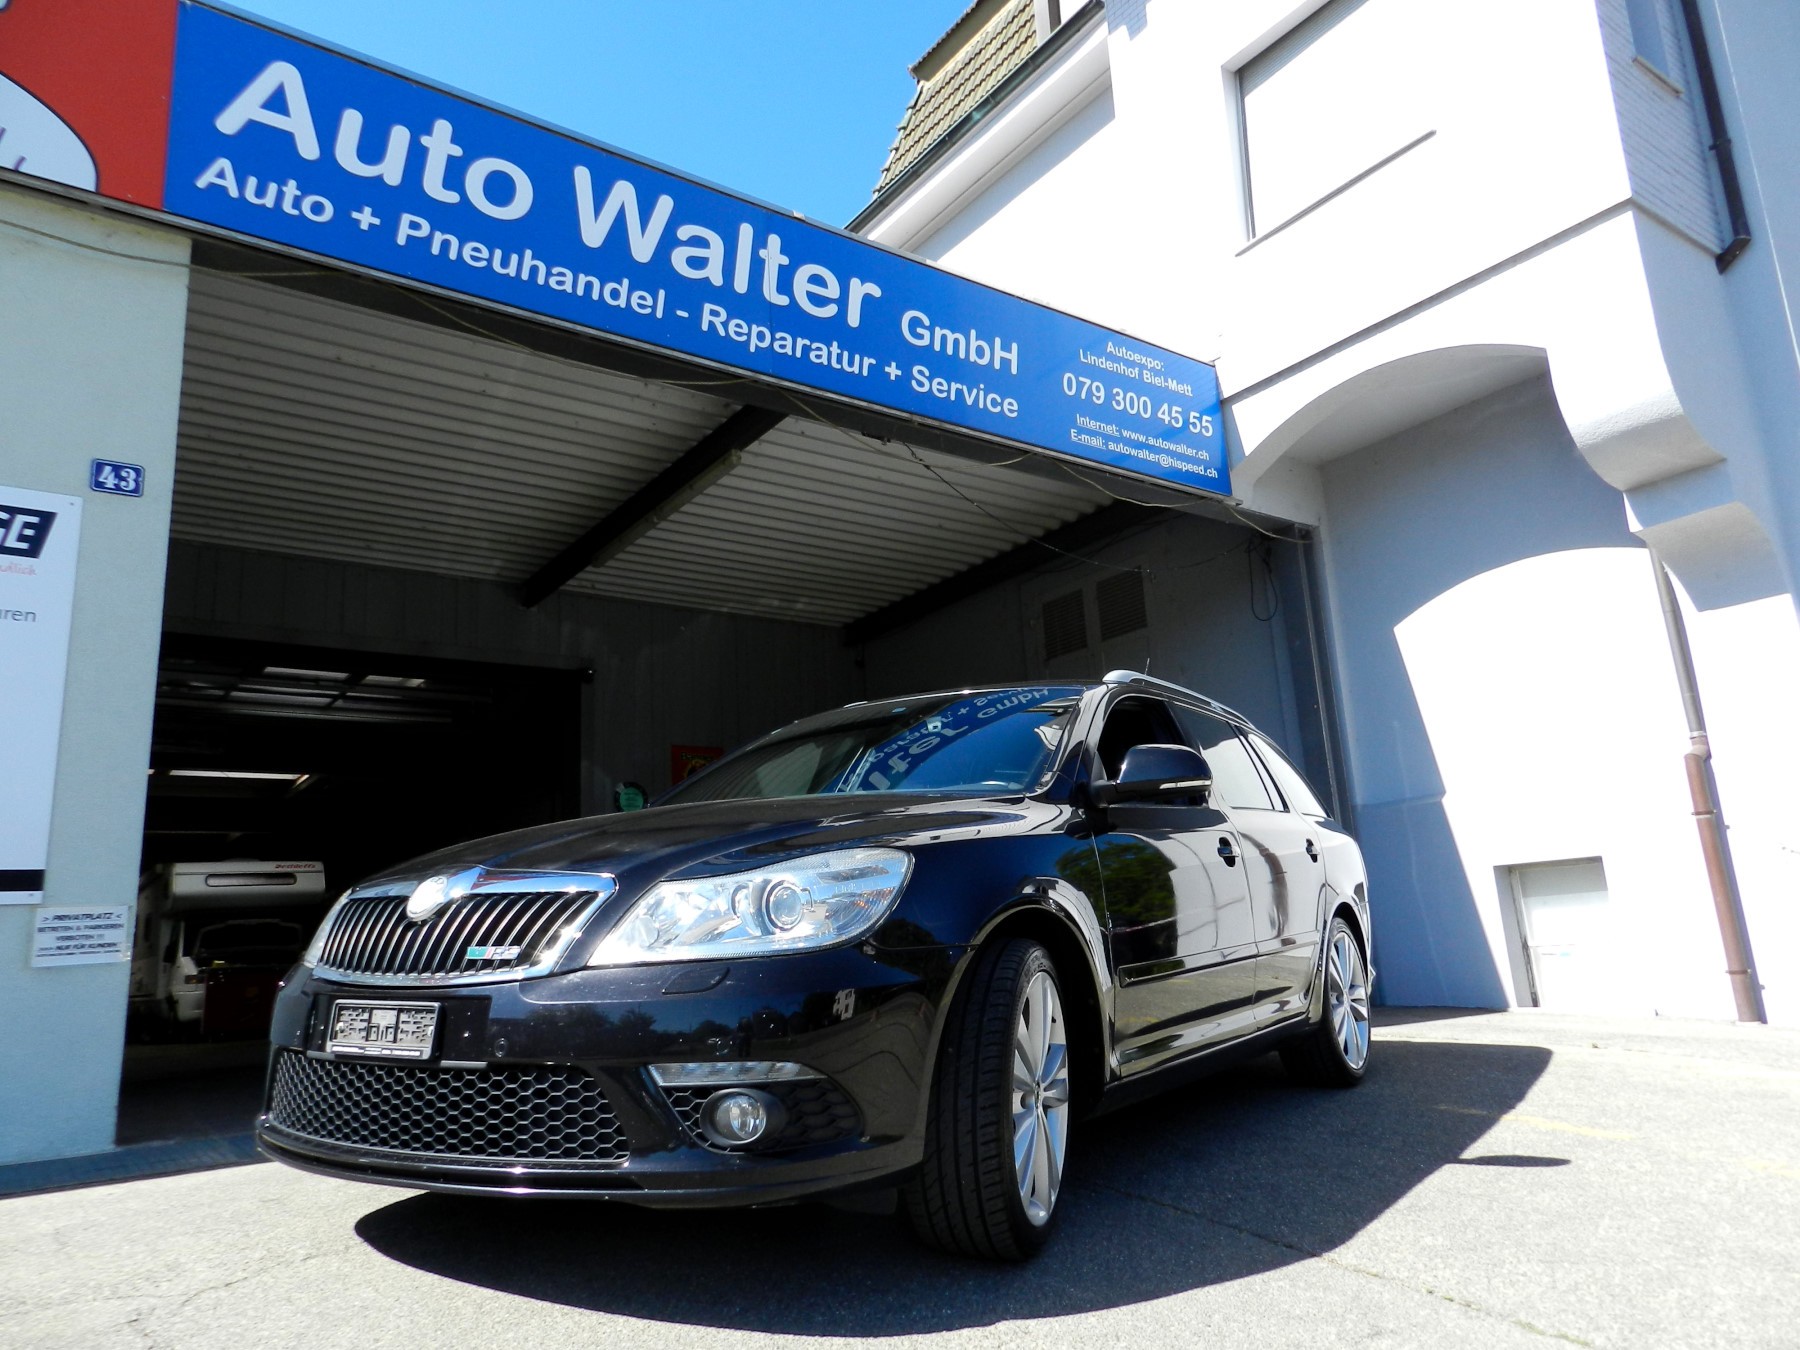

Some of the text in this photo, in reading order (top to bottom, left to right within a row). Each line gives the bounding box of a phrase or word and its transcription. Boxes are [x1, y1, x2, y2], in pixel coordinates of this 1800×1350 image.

[215, 61, 1019, 375] Auto Walter GmbH
[196, 158, 1019, 418] Auto + Pneuhandel - Reparatur + Service
[1079, 349, 1193, 396] Lindenhof Biel-Mett
[1107, 341, 1165, 371] Autoexpo:
[1063, 372, 1213, 437] 079 300 45 55
[1070, 428, 1218, 479] E-mail: autowalter@hispeed.ch
[1076, 413, 1210, 461] Internet: www.autowalter.ch
[98, 465, 138, 491] 43
[52, 912, 114, 921] PRIVATPLATZ
